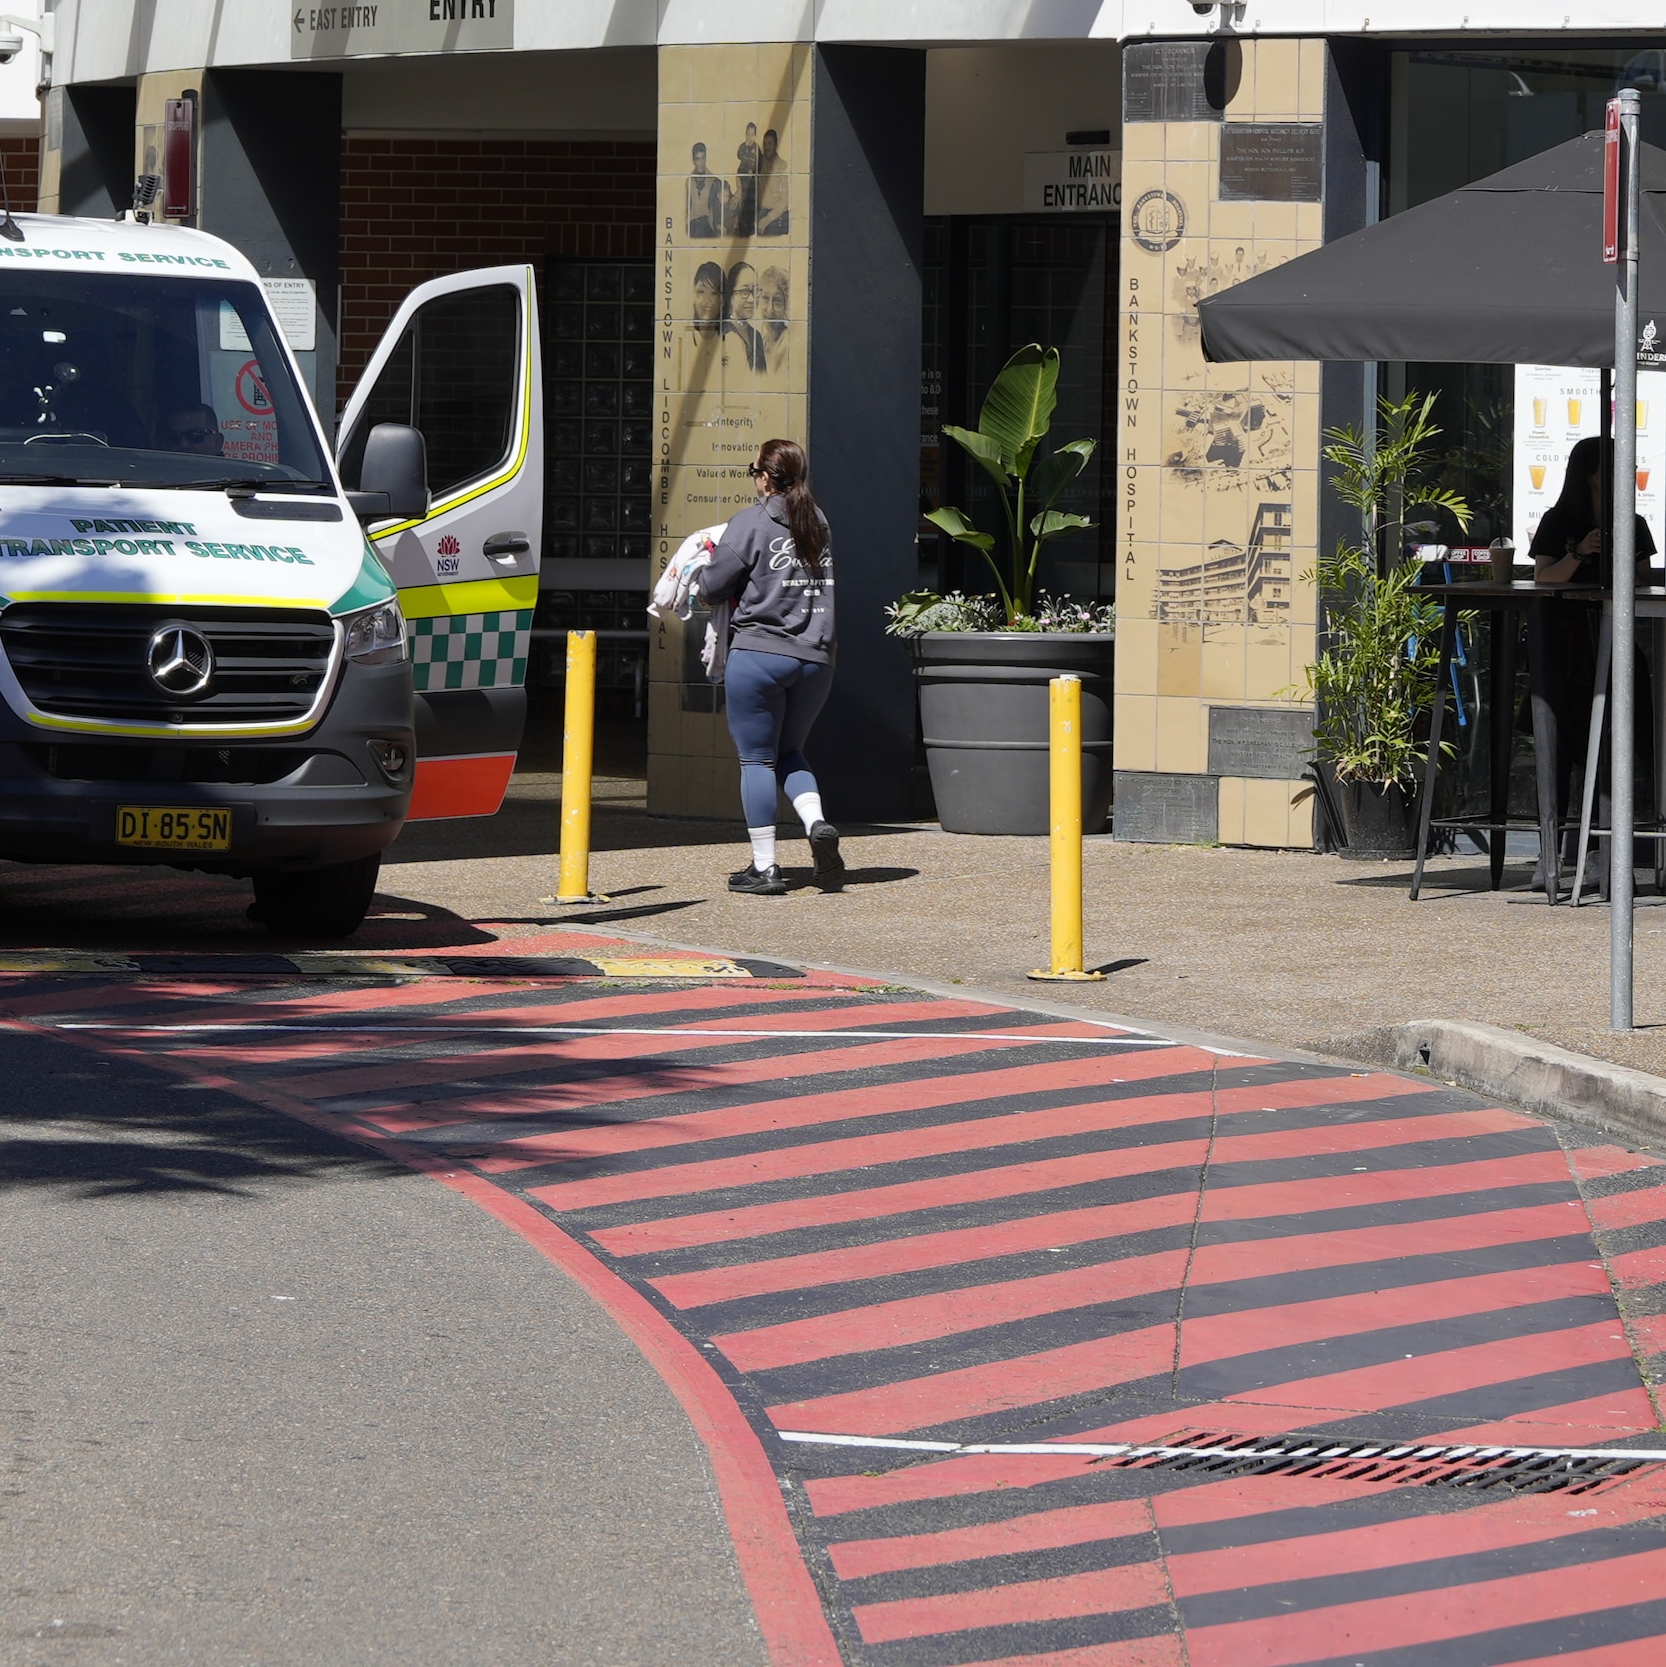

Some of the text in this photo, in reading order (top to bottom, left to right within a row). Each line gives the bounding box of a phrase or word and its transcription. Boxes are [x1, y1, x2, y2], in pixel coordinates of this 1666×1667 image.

[310, 5, 378, 31] EAST ENTRY
[1069, 155, 1111, 178] MAIN
[1043, 182, 1122, 207] ENTRANC
[119, 252, 231, 270] SERVICE
[921, 405, 939, 415] hese
[221, 420, 242, 430] USE
[1125, 278, 1139, 581] BANKSTOWN HOSPITAL
[250, 432, 273, 441] AND
[656, 217, 674, 651] BANKSTOWN LIDCOMBE HOSAL
[223, 442, 261, 451] AMERA
[729, 469, 751, 478] Work
[69, 519, 198, 536] PATIENT
[185, 540, 315, 565] SERVICE
[437, 558, 460, 572] NSW
[155, 840, 183, 848] SOUTH
